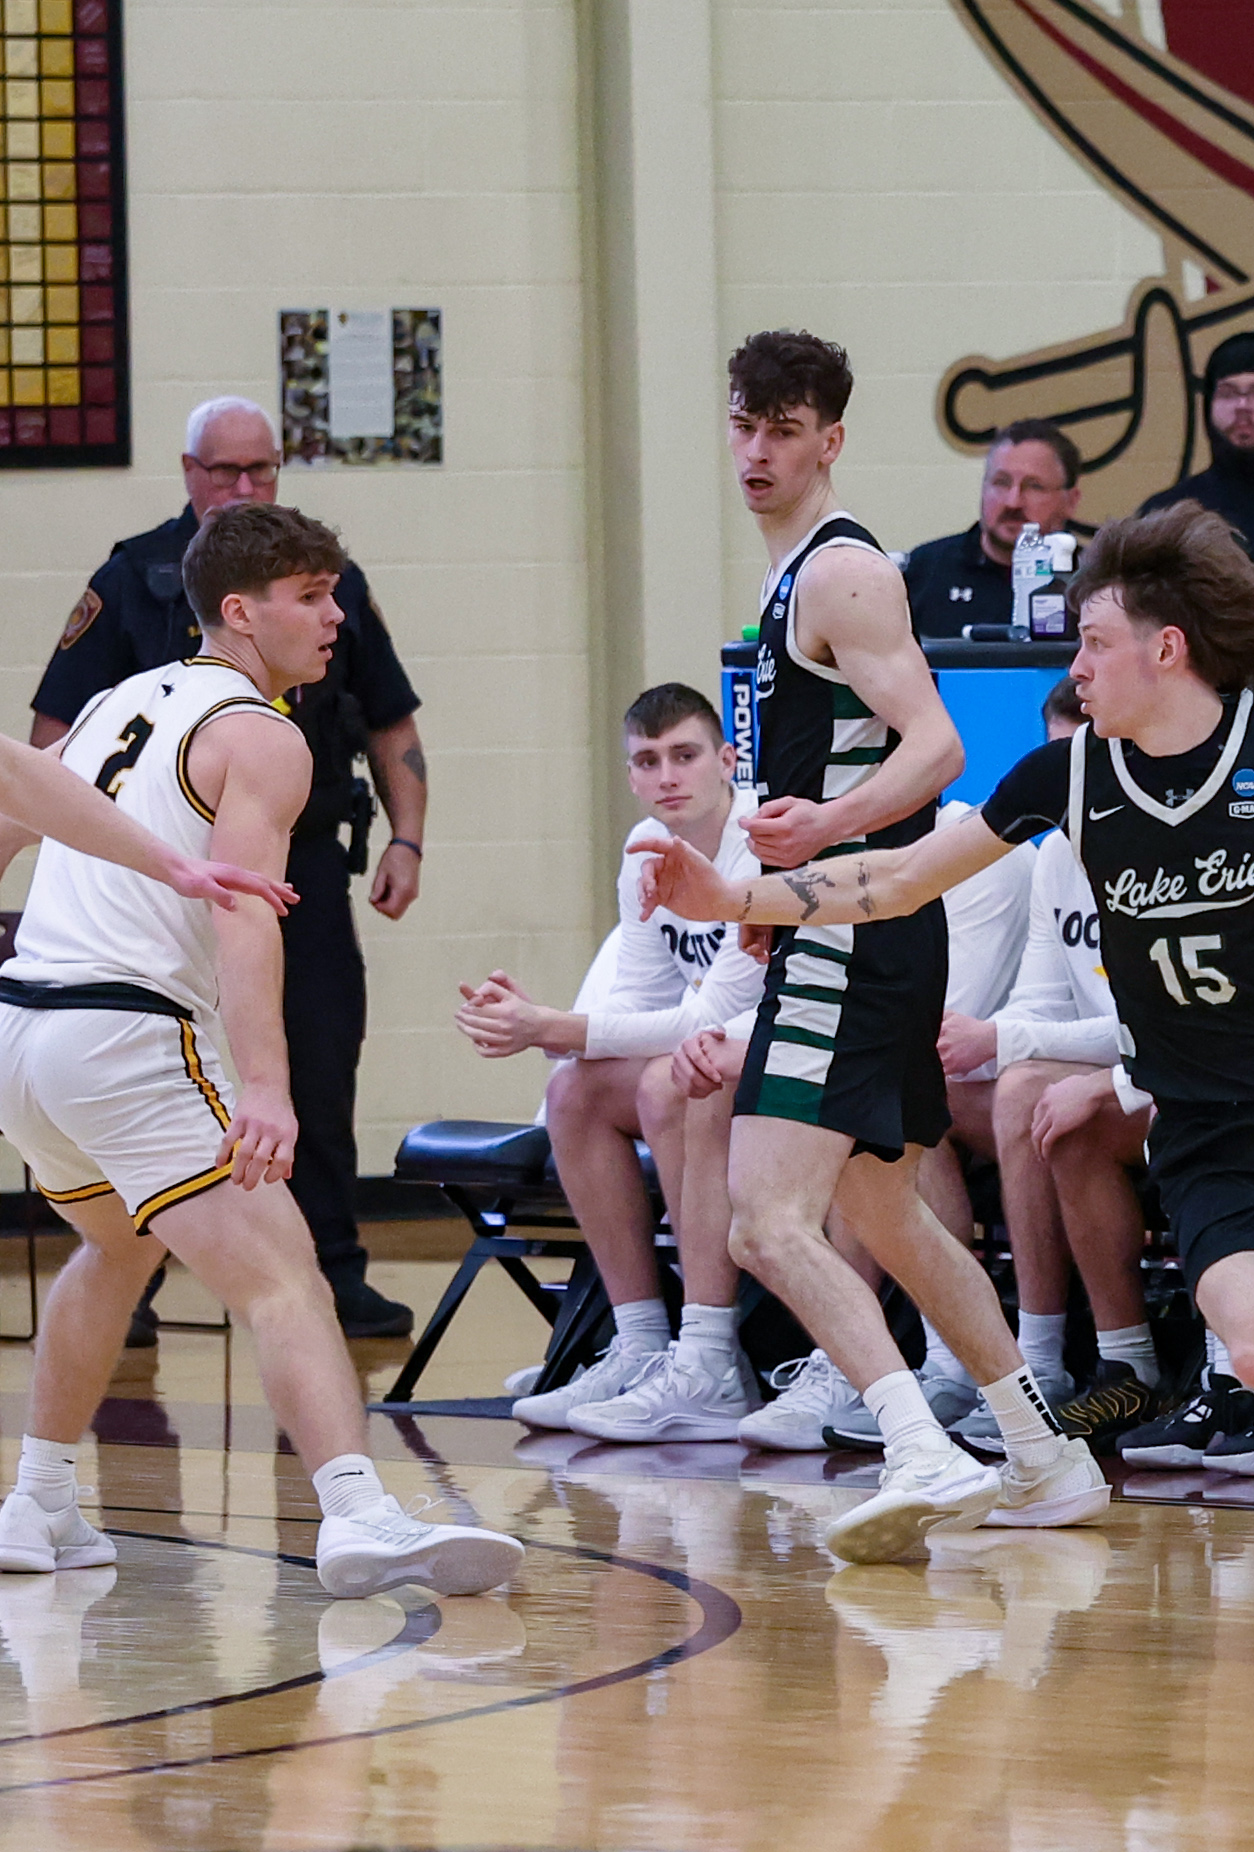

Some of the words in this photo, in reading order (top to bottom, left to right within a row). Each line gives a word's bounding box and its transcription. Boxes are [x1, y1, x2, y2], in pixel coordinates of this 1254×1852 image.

[94, 713, 154, 802] 2
[1104, 867, 1188, 917] Lake
[1149, 934, 1237, 1005] 15
